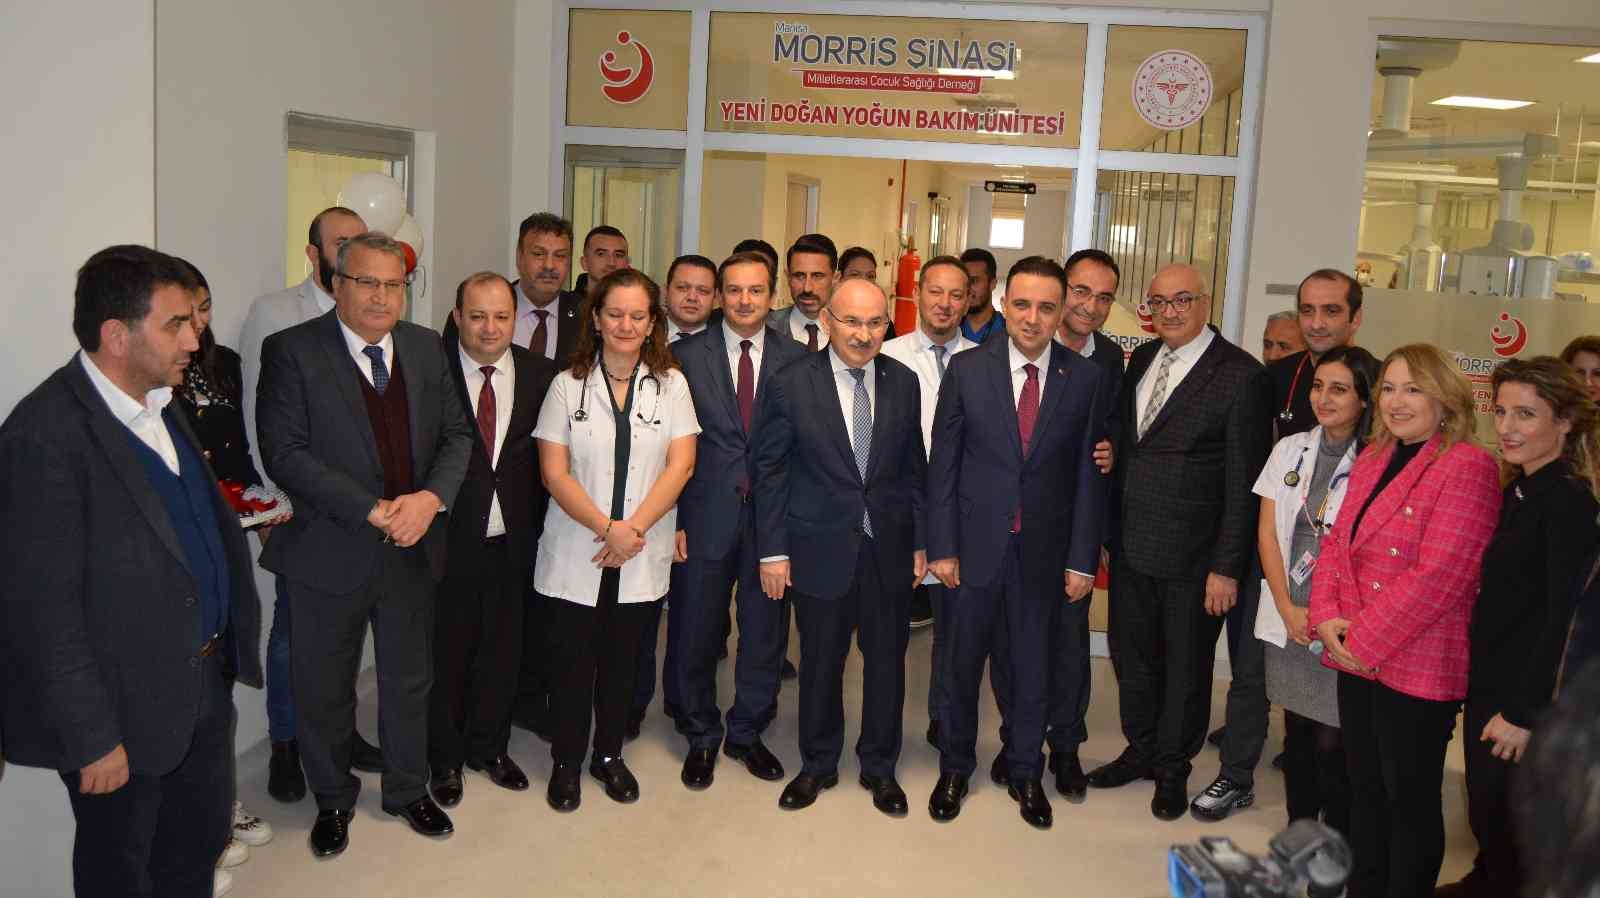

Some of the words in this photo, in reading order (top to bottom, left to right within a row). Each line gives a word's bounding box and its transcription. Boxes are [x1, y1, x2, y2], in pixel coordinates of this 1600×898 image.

[939, 78, 977, 92] Derneği
[720, 98, 766, 121] YENİ
[770, 99, 838, 125] DOĞAN
[842, 102, 911, 127] YOĞUN
[915, 109, 978, 131] BAKIM
[983, 108, 1065, 135] ÜNİTESİ
